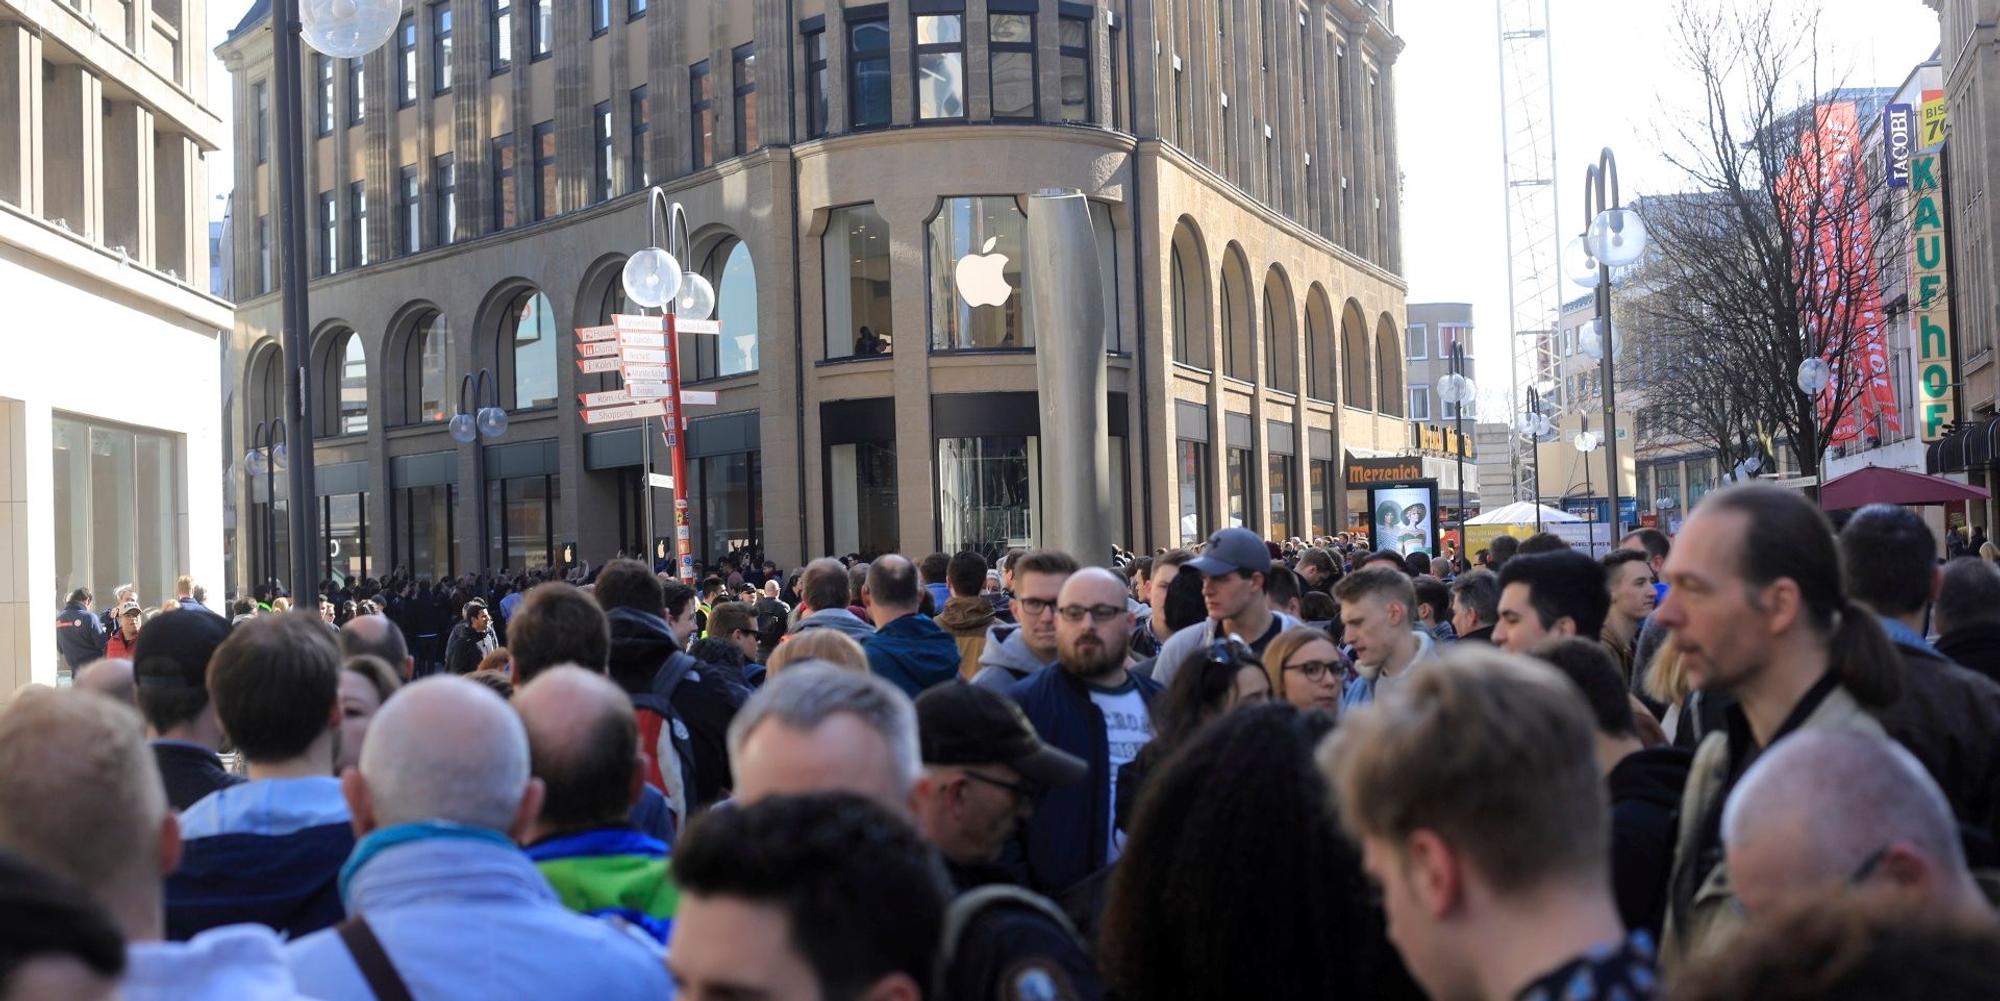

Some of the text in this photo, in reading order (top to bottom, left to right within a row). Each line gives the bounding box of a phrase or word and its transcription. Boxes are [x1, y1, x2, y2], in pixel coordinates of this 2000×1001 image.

[1926, 105, 1945, 118] BIS
[599, 409, 633, 419] Shopping
[1349, 464, 1419, 483] Merzenich
